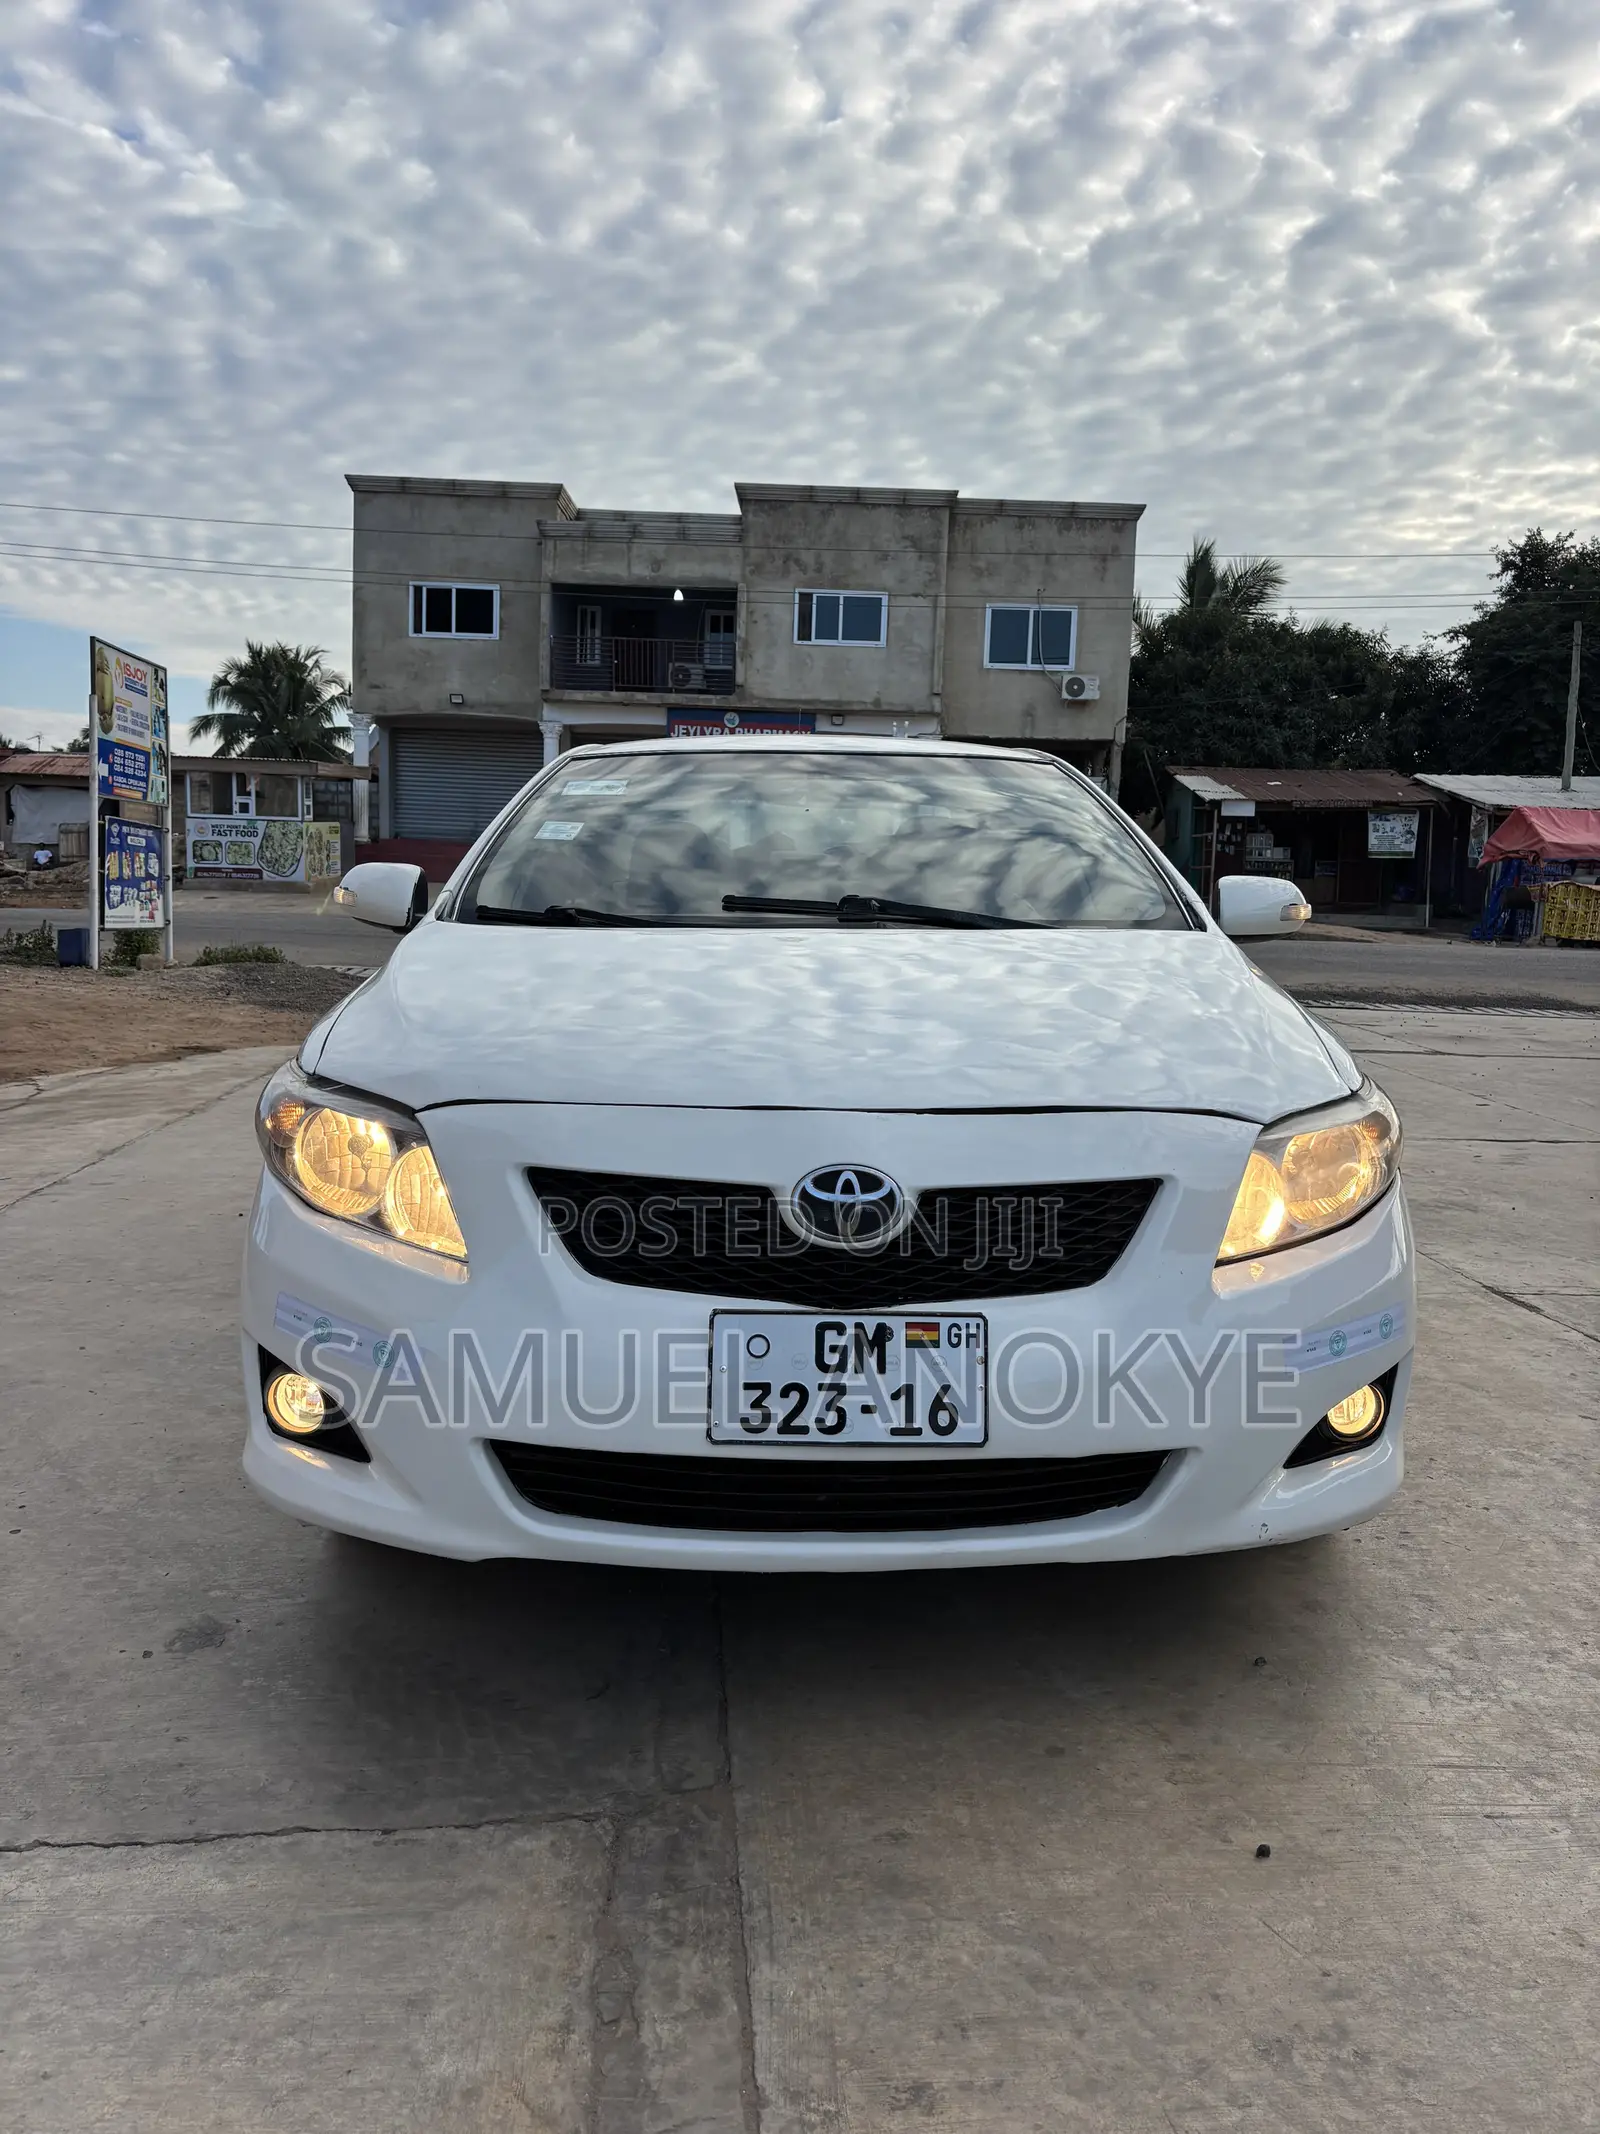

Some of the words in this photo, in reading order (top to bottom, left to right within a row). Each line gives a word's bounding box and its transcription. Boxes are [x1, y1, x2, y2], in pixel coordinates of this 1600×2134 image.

[123, 661, 148, 683] ISJOY
[211, 829, 233, 837] FAST
[235, 830, 259, 838] FOOD
[815, 1321, 887, 1375] GM
[947, 1322, 981, 1349] GH
[739, 1382, 959, 1437] 323-16
